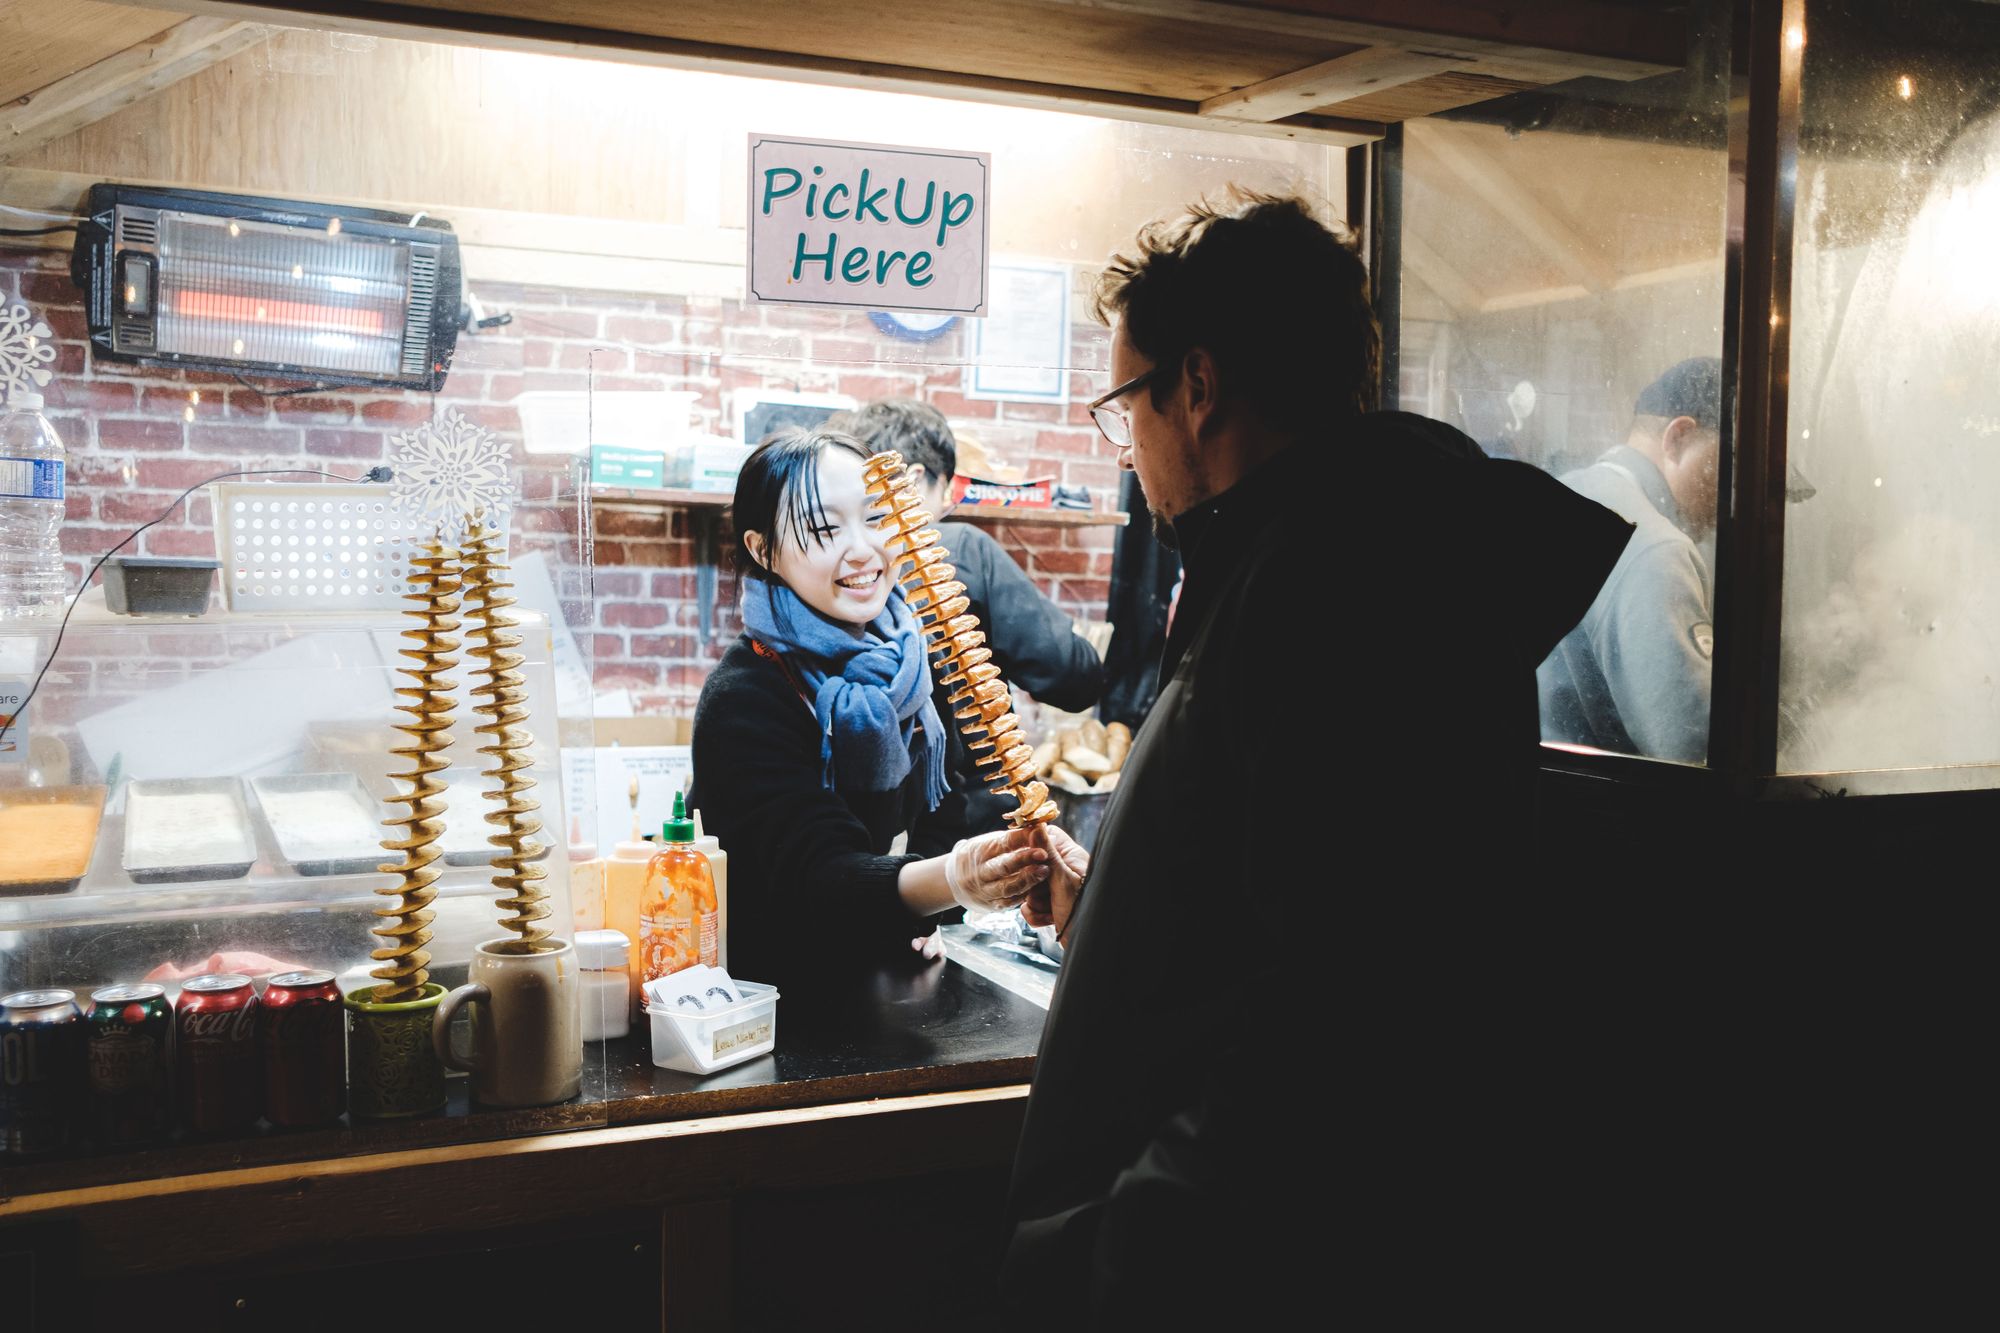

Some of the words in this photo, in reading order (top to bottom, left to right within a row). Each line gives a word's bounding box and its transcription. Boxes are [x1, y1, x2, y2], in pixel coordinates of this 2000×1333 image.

[763, 165, 974, 247] PickUp
[793, 232, 934, 287] Here
[1020, 488, 1045, 502] PIE
